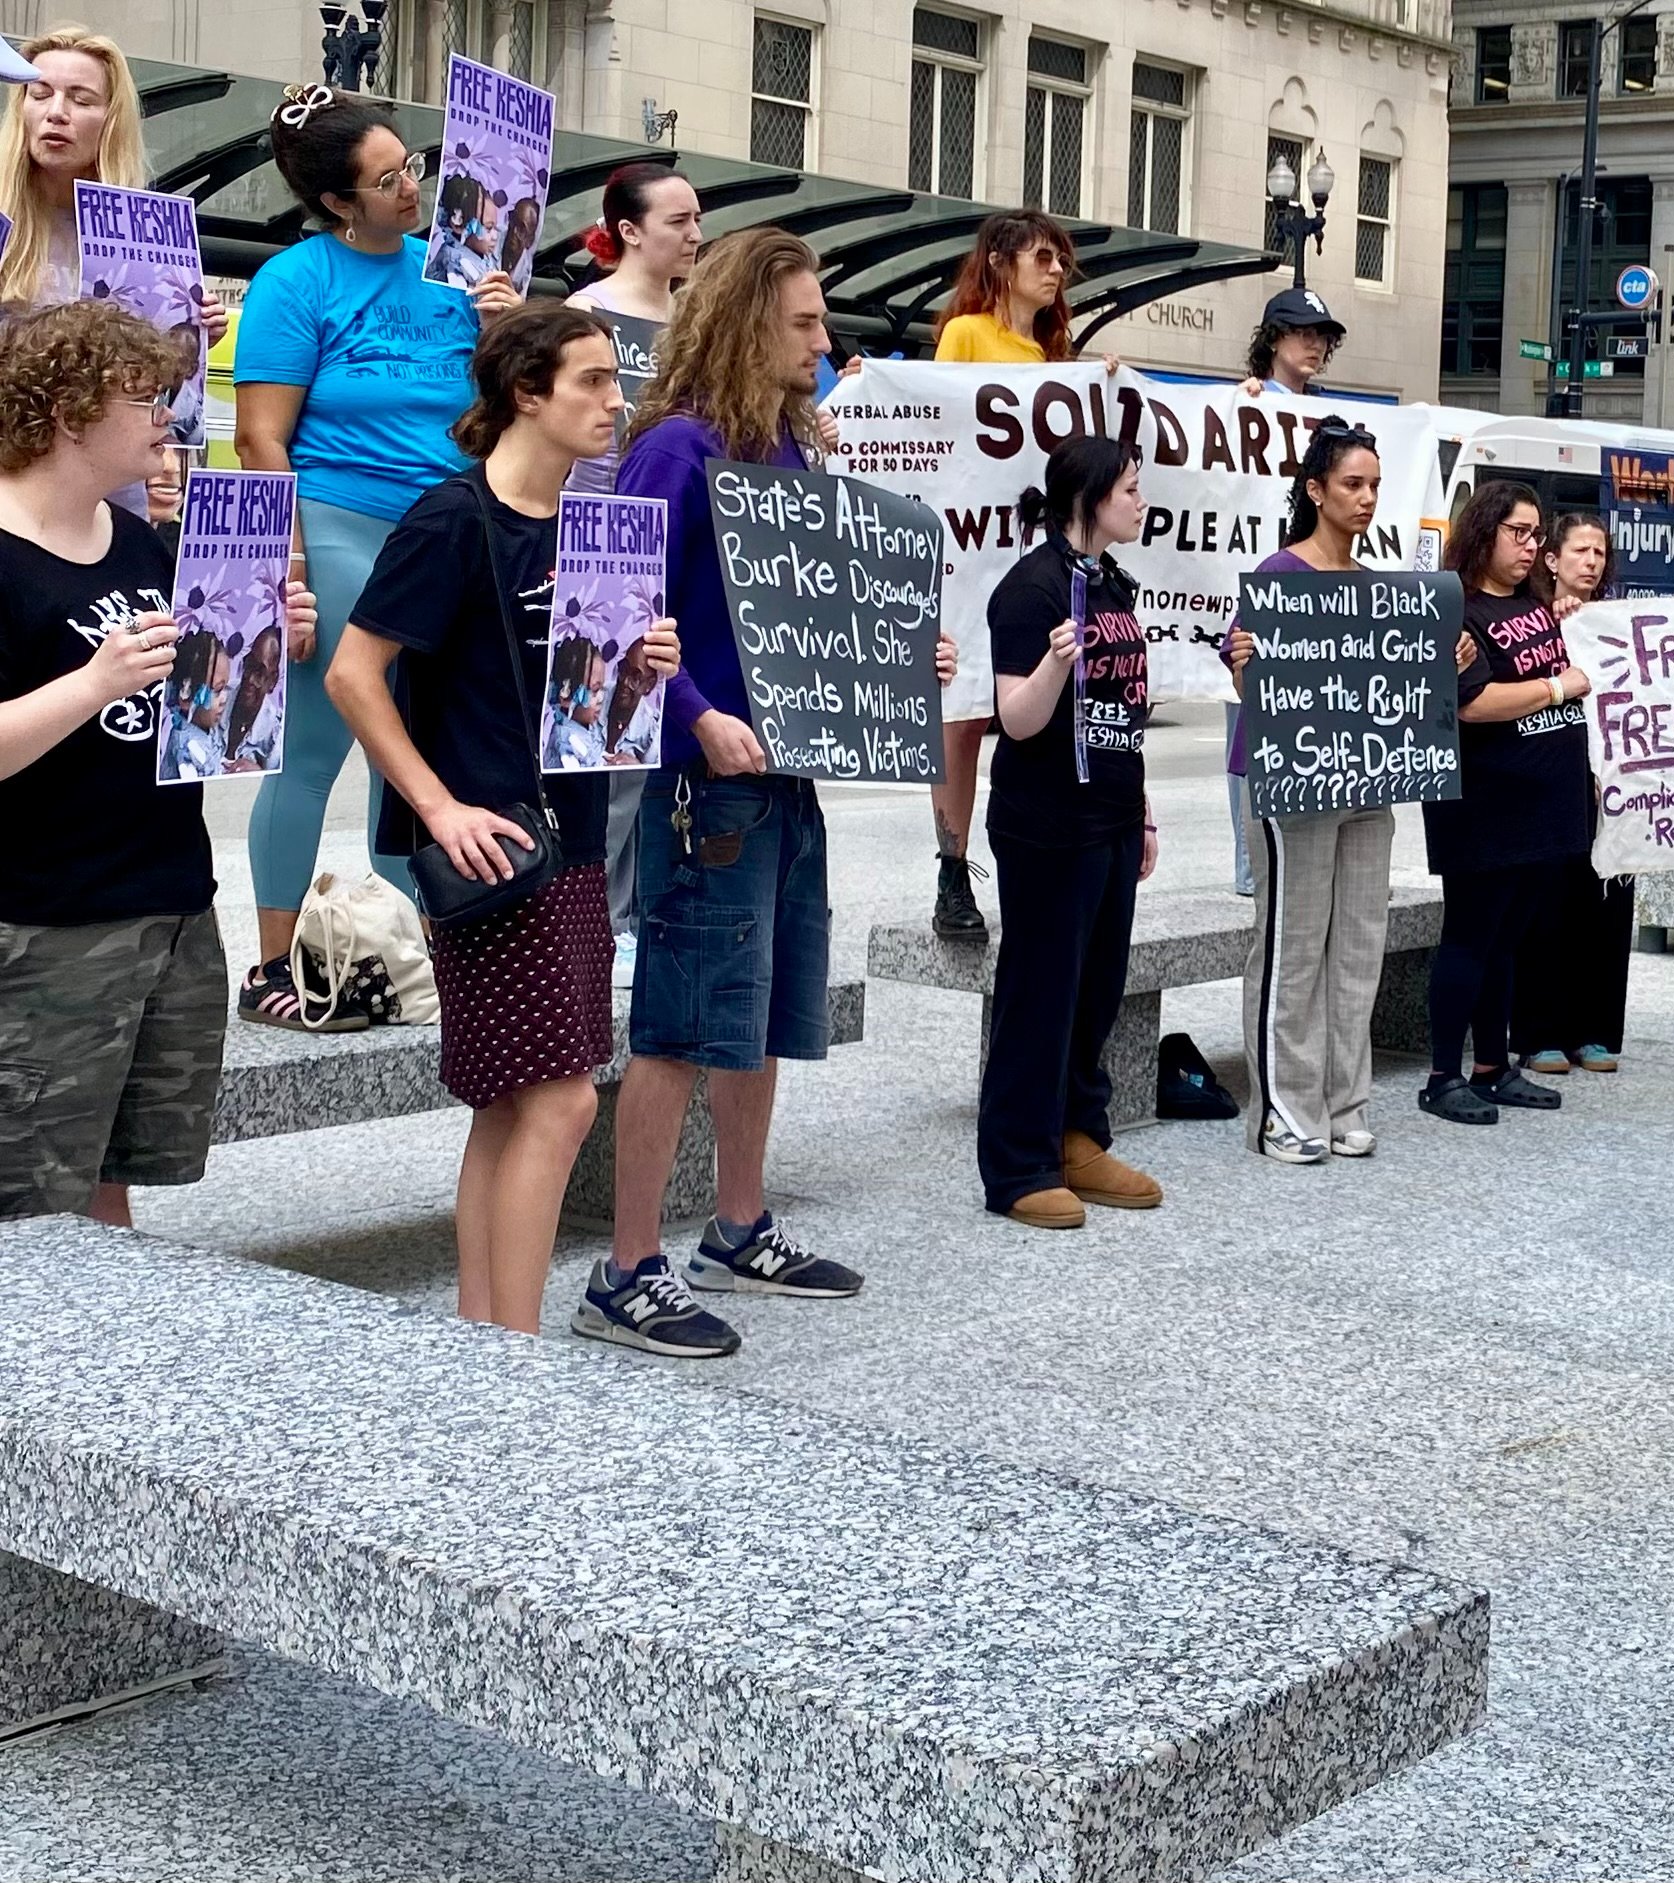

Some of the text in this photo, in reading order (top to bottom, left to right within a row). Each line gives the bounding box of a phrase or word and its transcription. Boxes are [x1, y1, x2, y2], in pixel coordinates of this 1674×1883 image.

[450, 61, 552, 140] FREE KESHIA
[451, 108, 548, 155] DROP THE CHARGES
[77, 188, 126, 240] FREE
[127, 196, 197, 250] KESHIA
[84, 243, 197, 268] DROP THE CHARGES
[1622, 280, 1647, 293] cta
[373, 305, 411, 324] BUILD
[377, 324, 446, 342] COMMUNITY
[1147, 302, 1214, 331] CHURCH
[386, 362, 462, 380] NOT PRISONS
[830, 405, 941, 420] VERBAL ABUSE
[848, 458, 879, 474] FOR
[902, 458, 939, 473] DAYS
[858, 440, 955, 456] COMMISSARY
[184, 477, 293, 536] FREE KESHIA
[560, 500, 665, 556] FREE KESHIA
[715, 471, 940, 597] State's Attorney
[1227, 514, 1261, 554] AT
[184, 543, 288, 559] DROP THE CHARGES
[561, 558, 663, 576] DROP THE CHARGES
[722, 532, 939, 630] Burke Discourages
[1246, 581, 1440, 621] When will Black
[738, 600, 914, 666] Survival. She
[1251, 627, 1438, 664] Women and Girls
[1531, 638, 1556, 668] NOT
[751, 667, 928, 727] Spends Millions
[1259, 674, 1432, 727] Have the Right
[1084, 726, 1130, 748] ESHIA
[1516, 708, 1564, 733] KESHIA
[762, 716, 937, 779] Prosecuting Victims.
[1254, 725, 1457, 778] to Self-Defence
